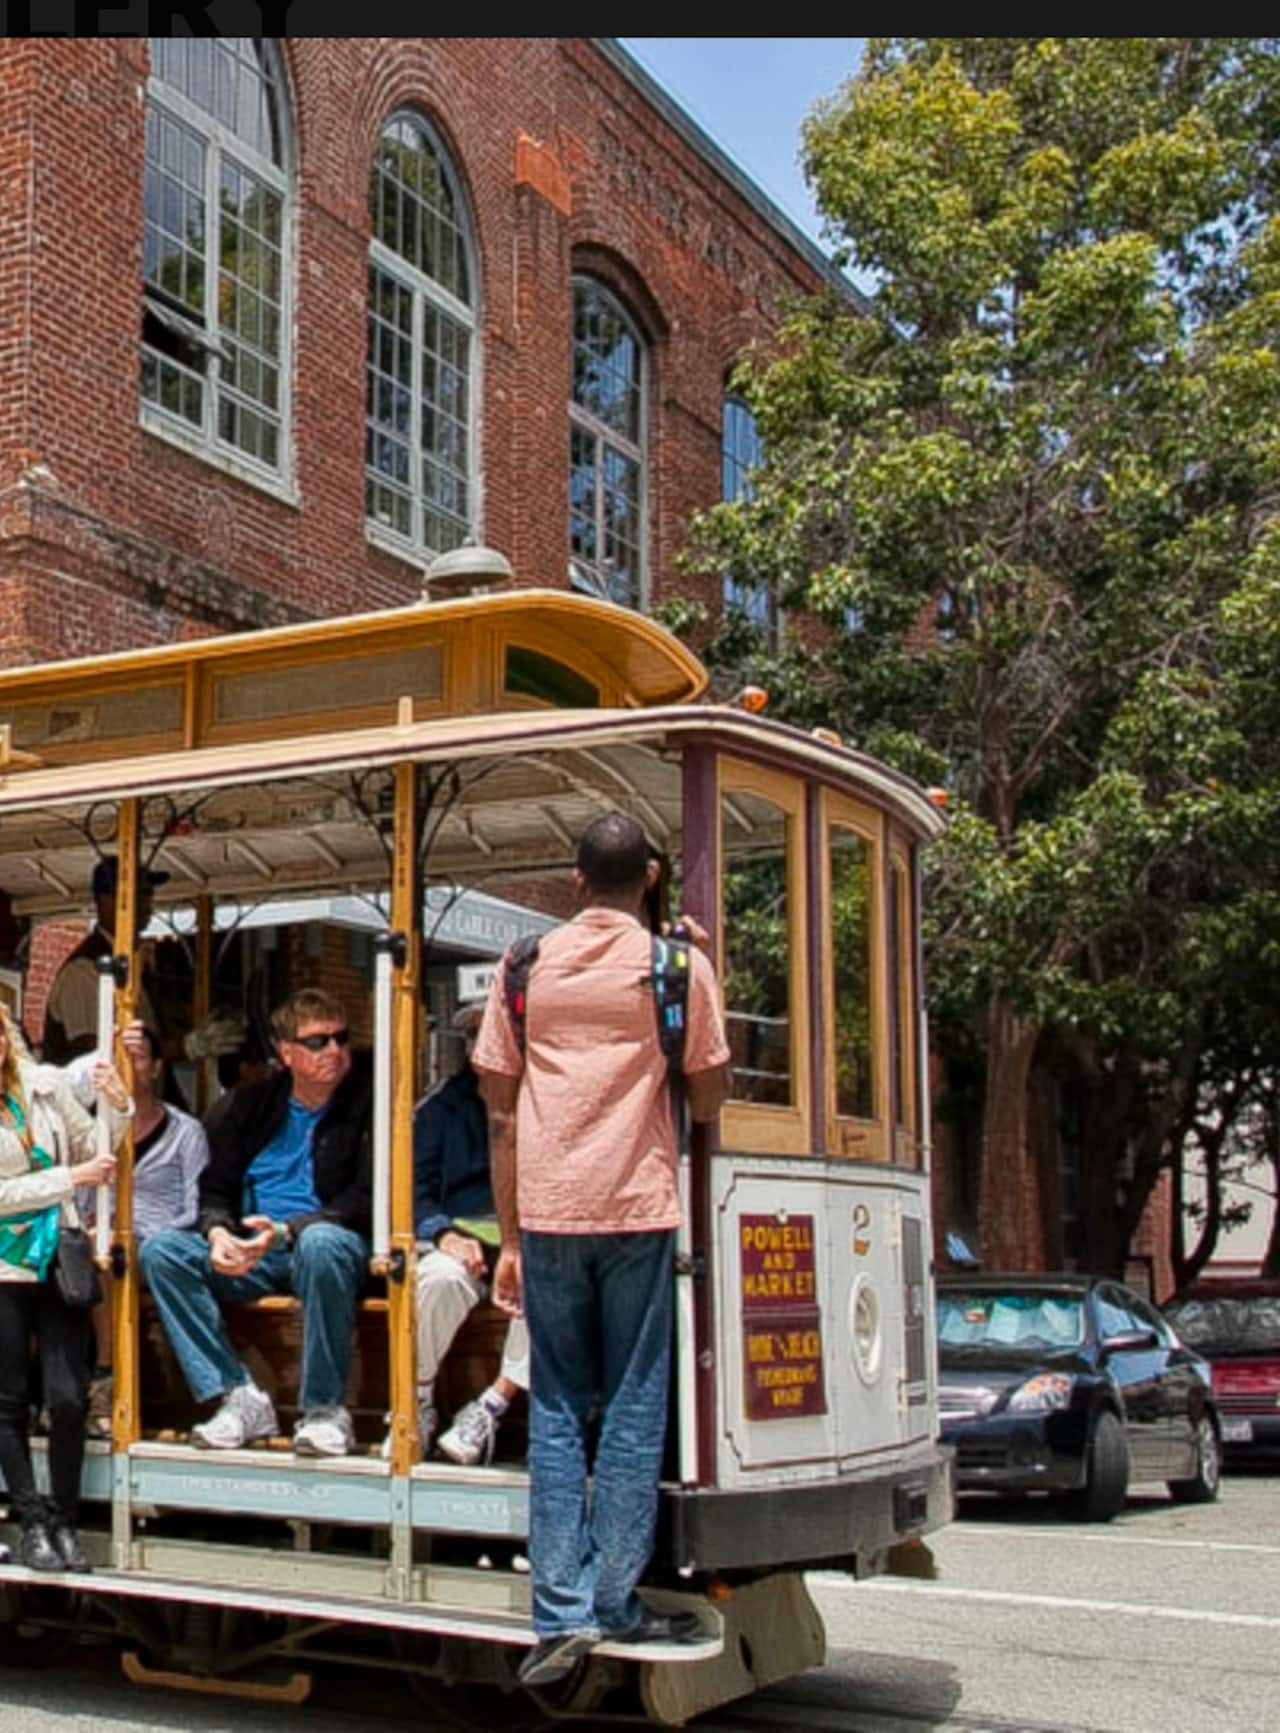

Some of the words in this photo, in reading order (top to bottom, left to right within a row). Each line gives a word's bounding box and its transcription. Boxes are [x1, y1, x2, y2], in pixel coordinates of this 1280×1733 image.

[741, 1225, 813, 1251] POWELL
[852, 1203, 871, 1257] 2
[762, 1252, 796, 1271] AND
[742, 1270, 815, 1298] MARKET
